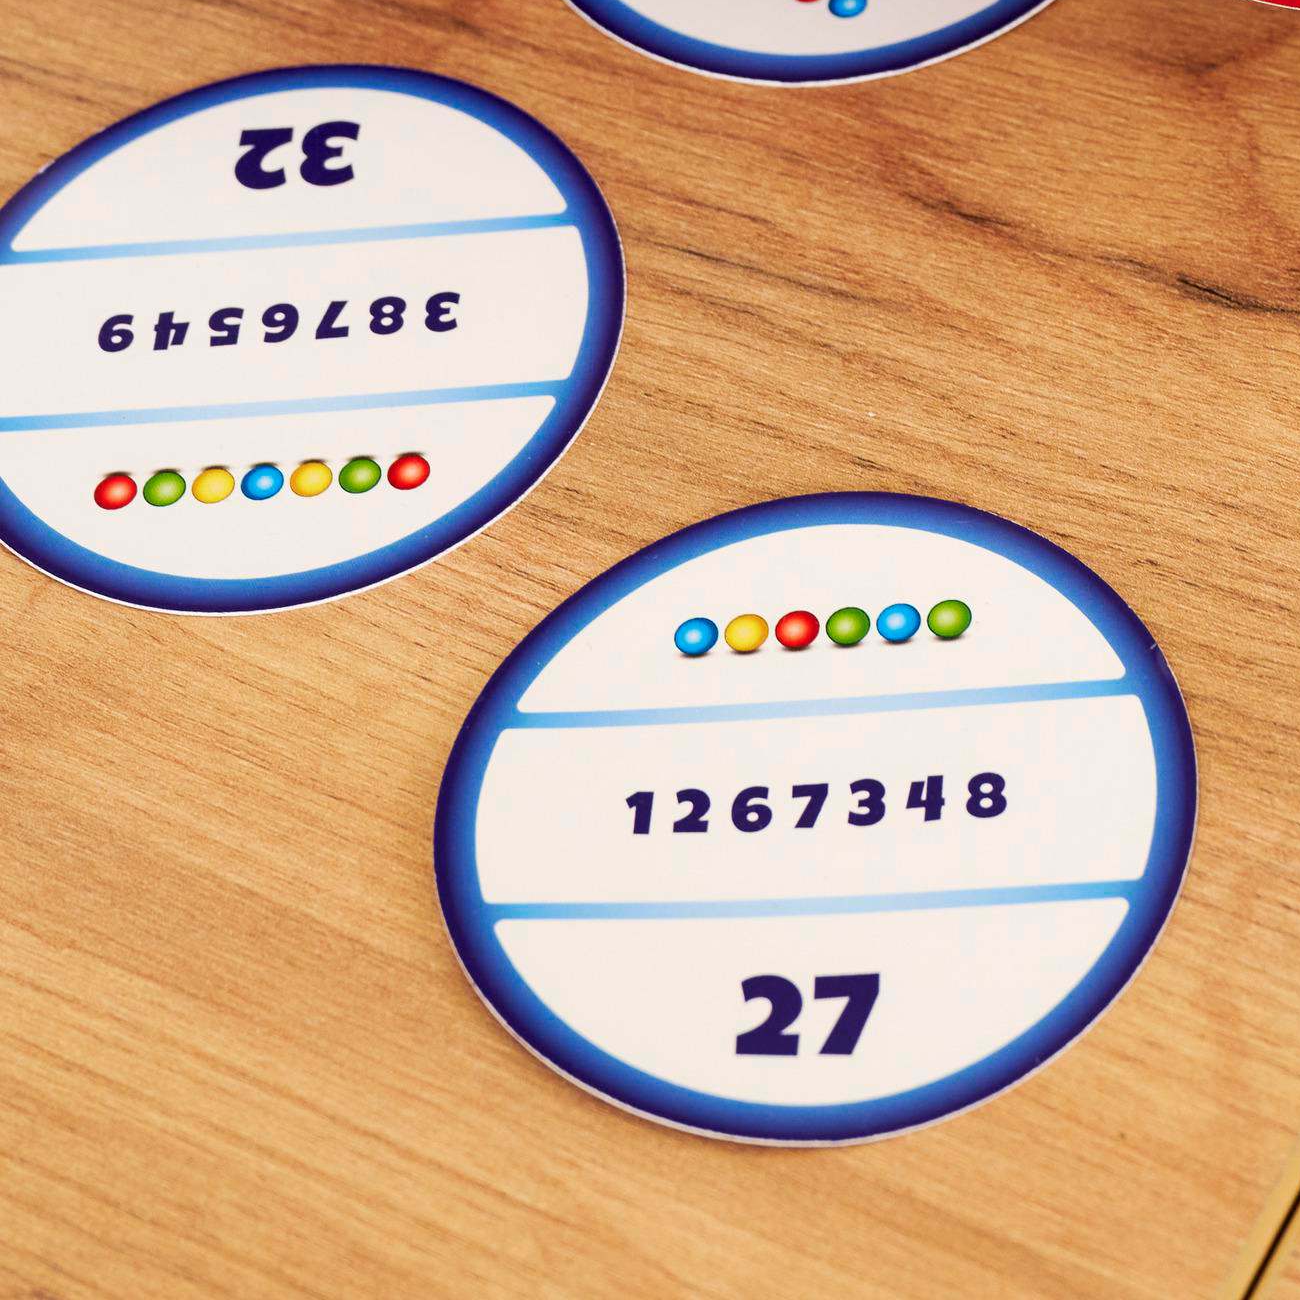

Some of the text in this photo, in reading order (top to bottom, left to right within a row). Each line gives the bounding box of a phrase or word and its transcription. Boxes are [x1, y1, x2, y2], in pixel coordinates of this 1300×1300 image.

[234, 120, 361, 190] 32
[97, 291, 461, 353] 3876549
[625, 771, 1008, 835] 1267348
[735, 972, 881, 1057] 27
